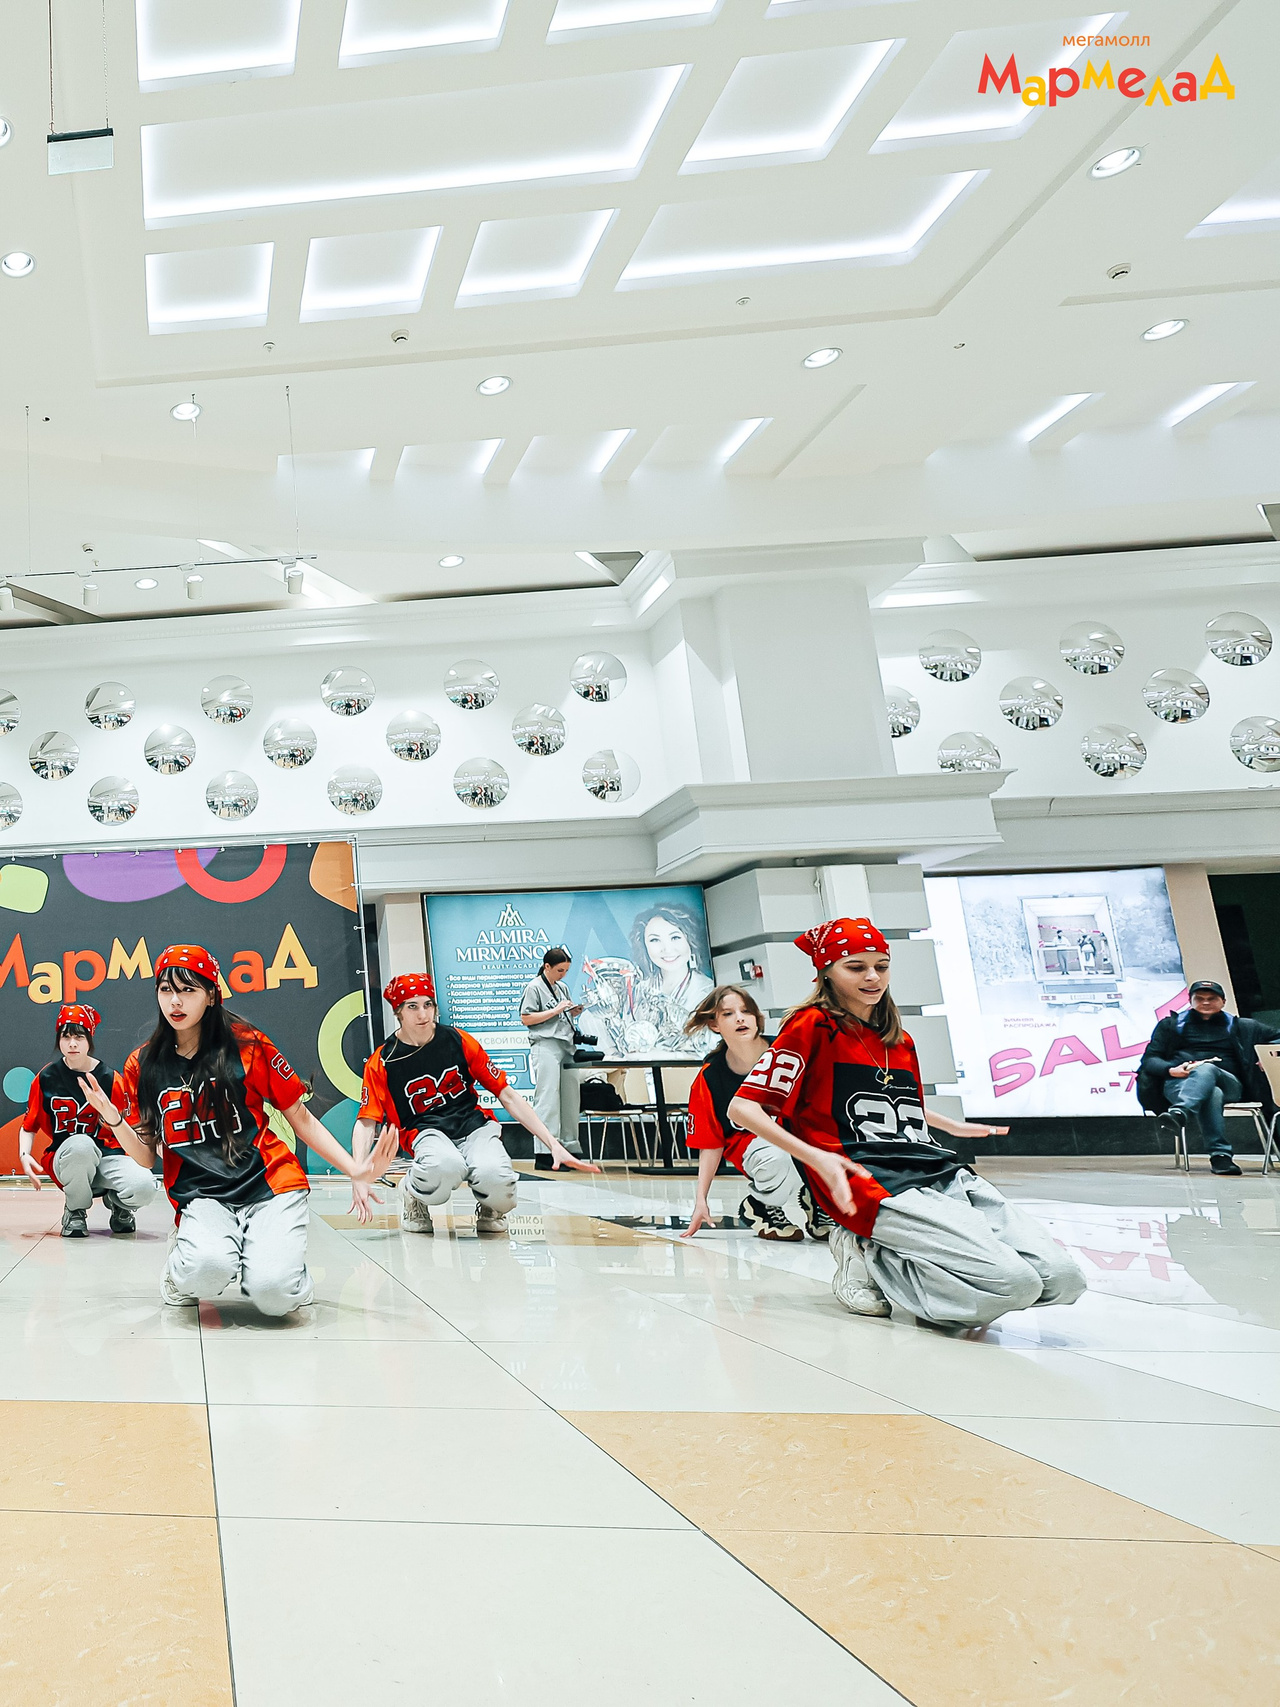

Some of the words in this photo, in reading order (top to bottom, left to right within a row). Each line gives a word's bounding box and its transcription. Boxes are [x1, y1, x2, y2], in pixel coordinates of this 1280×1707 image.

[476, 929, 550, 945] ALMIRA
[456, 944, 573, 962] MIRMANO
[483, 1036, 509, 1045] СВОЙ
[742, 1048, 805, 1097] 22
[1109, 1071, 1138, 1092] -7
[404, 1065, 467, 1115] 24
[51, 1096, 99, 1137] 24
[847, 1093, 940, 1147] 22
